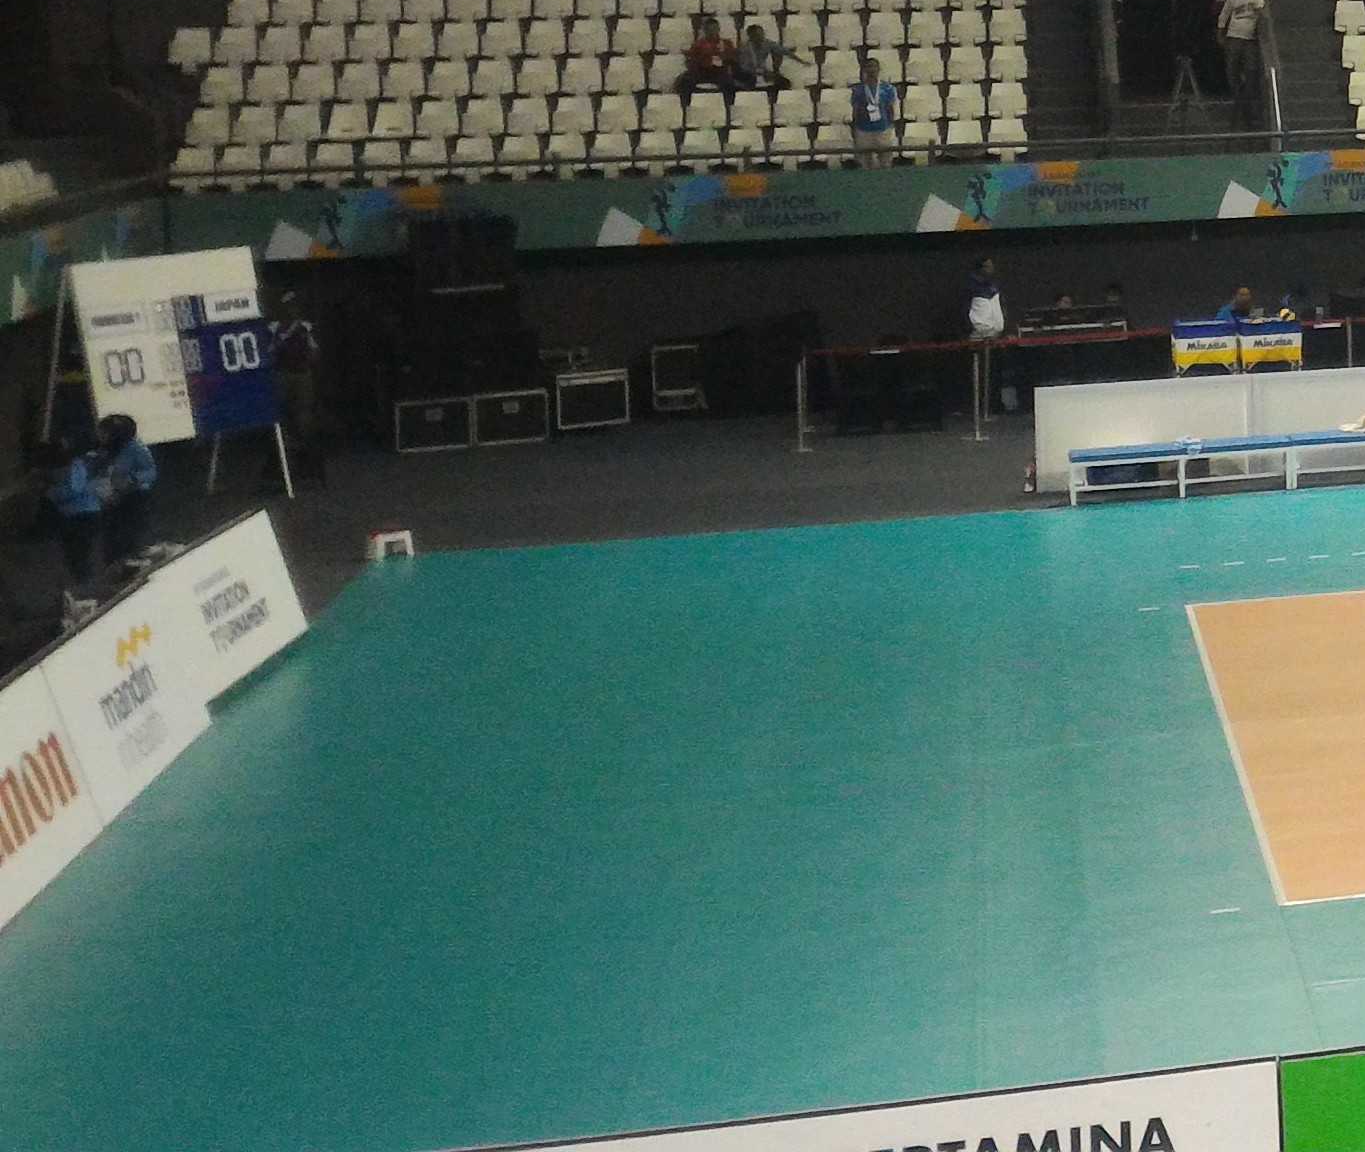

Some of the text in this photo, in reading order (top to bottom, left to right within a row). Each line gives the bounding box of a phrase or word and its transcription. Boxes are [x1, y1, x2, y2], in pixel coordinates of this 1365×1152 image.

[104, 347, 145, 390] 00
[218, 330, 261, 372] 00
[0, 732, 79, 868] non
